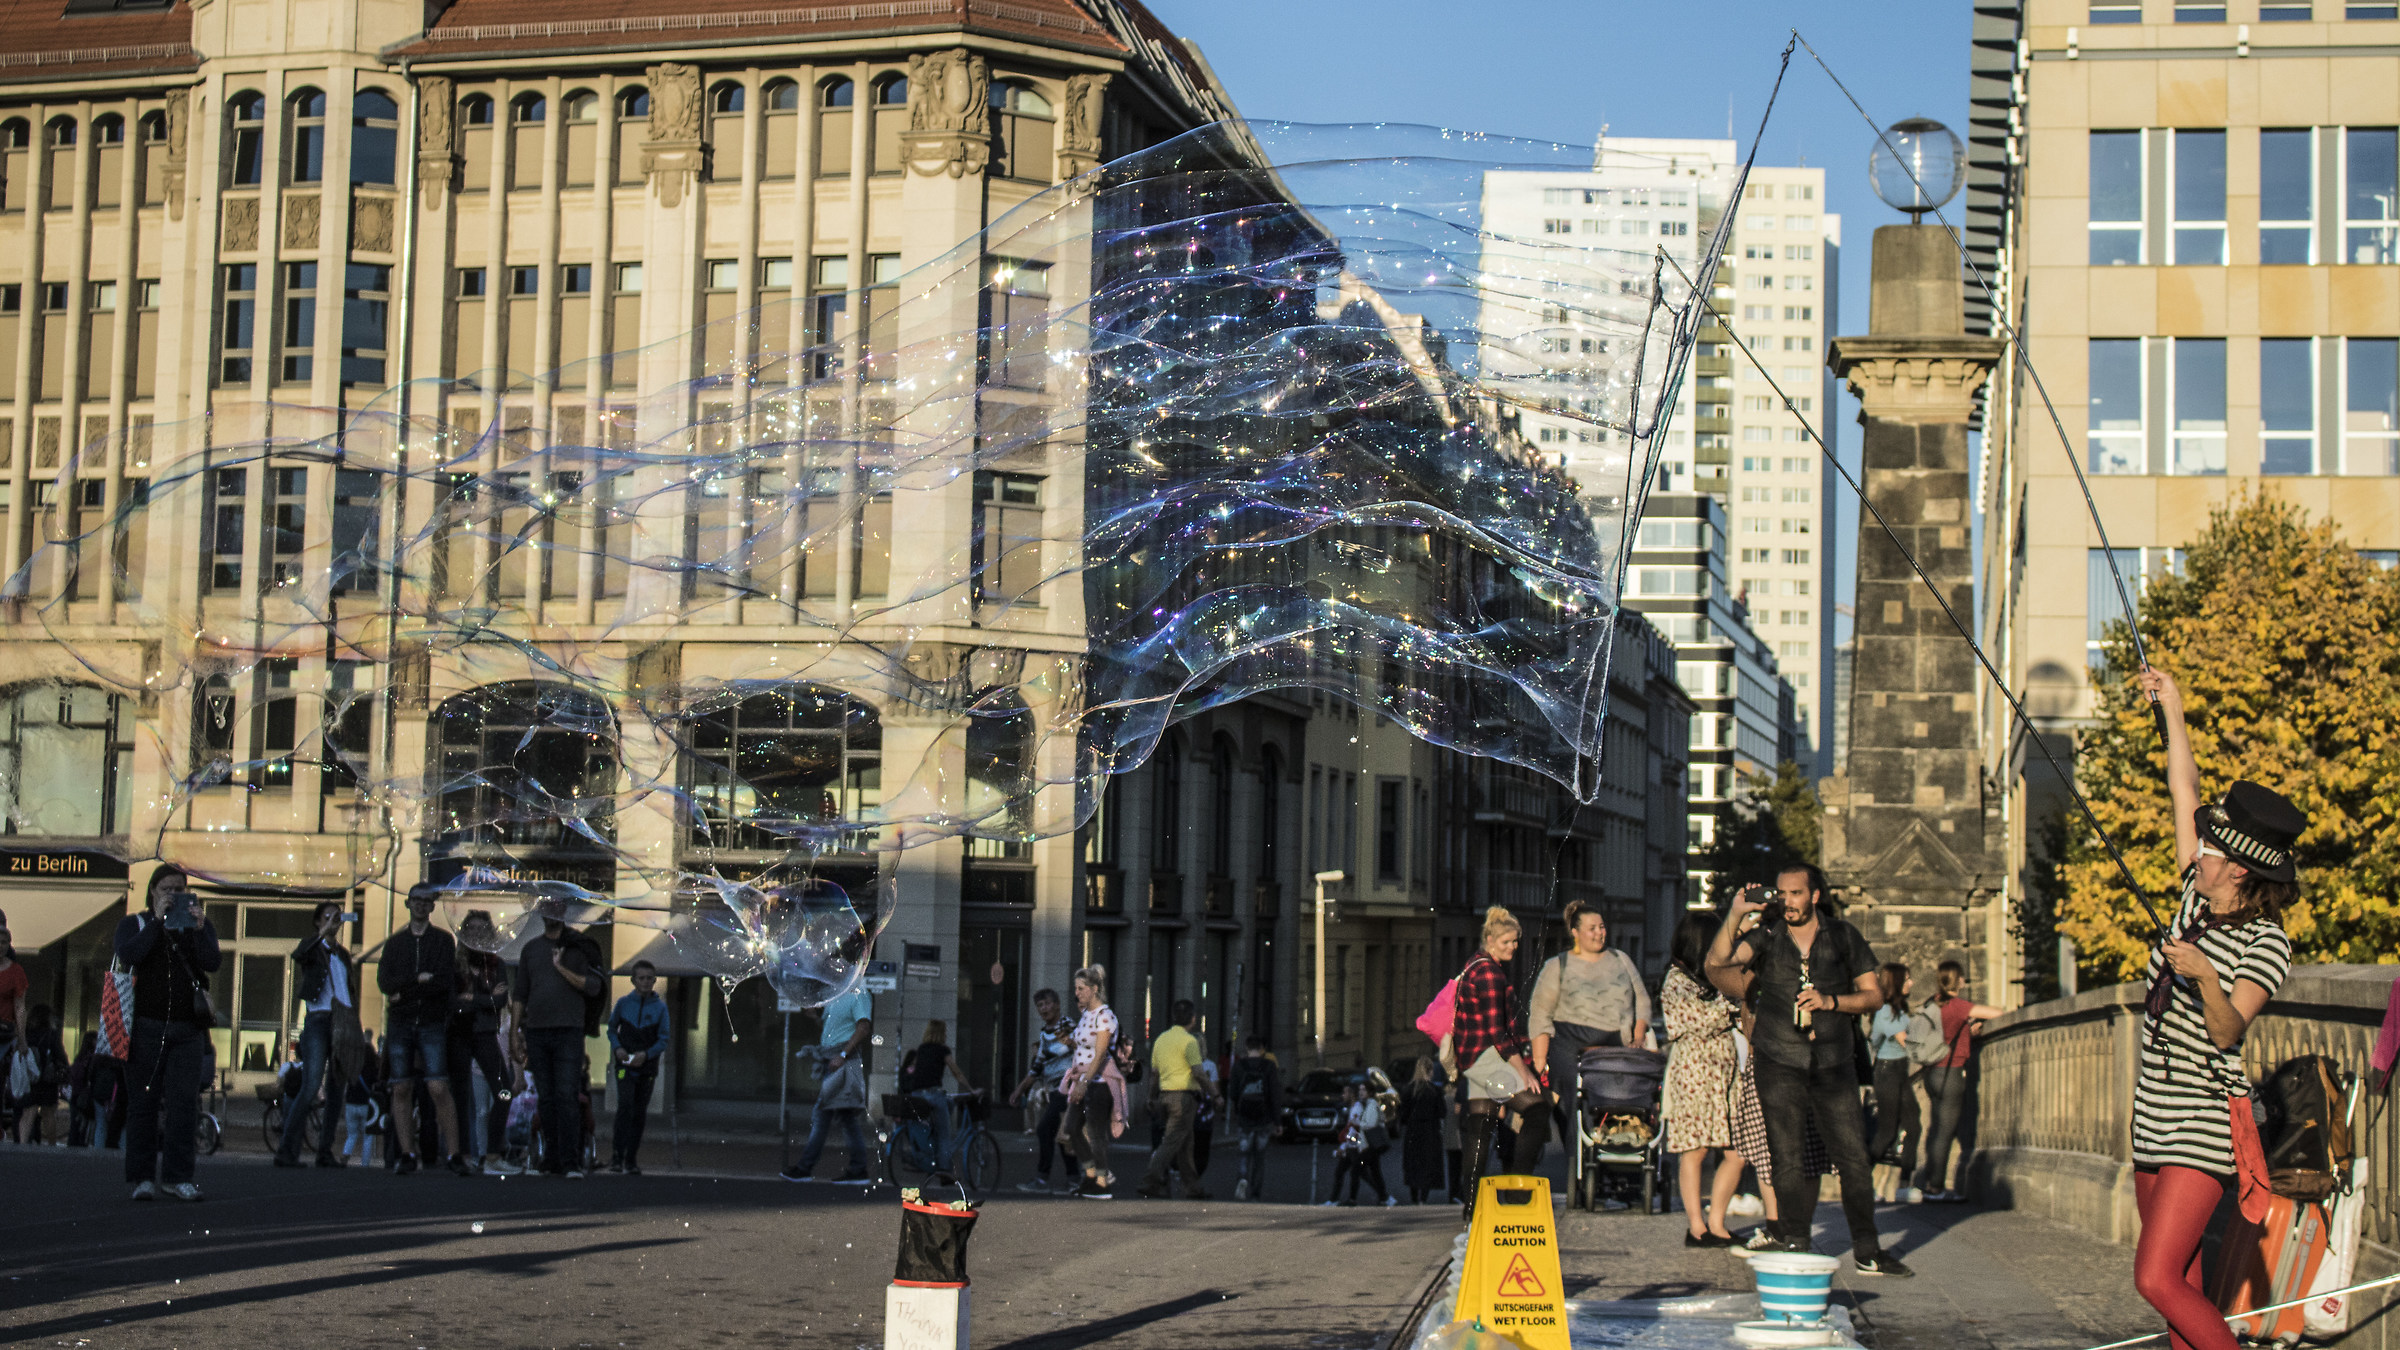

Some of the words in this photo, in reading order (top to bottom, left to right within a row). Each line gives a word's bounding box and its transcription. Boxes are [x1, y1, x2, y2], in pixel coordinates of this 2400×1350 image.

[11, 856, 31, 872] zu
[38, 854, 89, 874] Berlin
[1493, 1225, 1545, 1234] ACHTUNG
[1493, 1237, 1547, 1247] CAUTION
[1494, 1303, 1554, 1312] RUTSCHGEFAHR
[1494, 1316, 1517, 1326] WET
[1521, 1316, 1556, 1326] FLOOR
